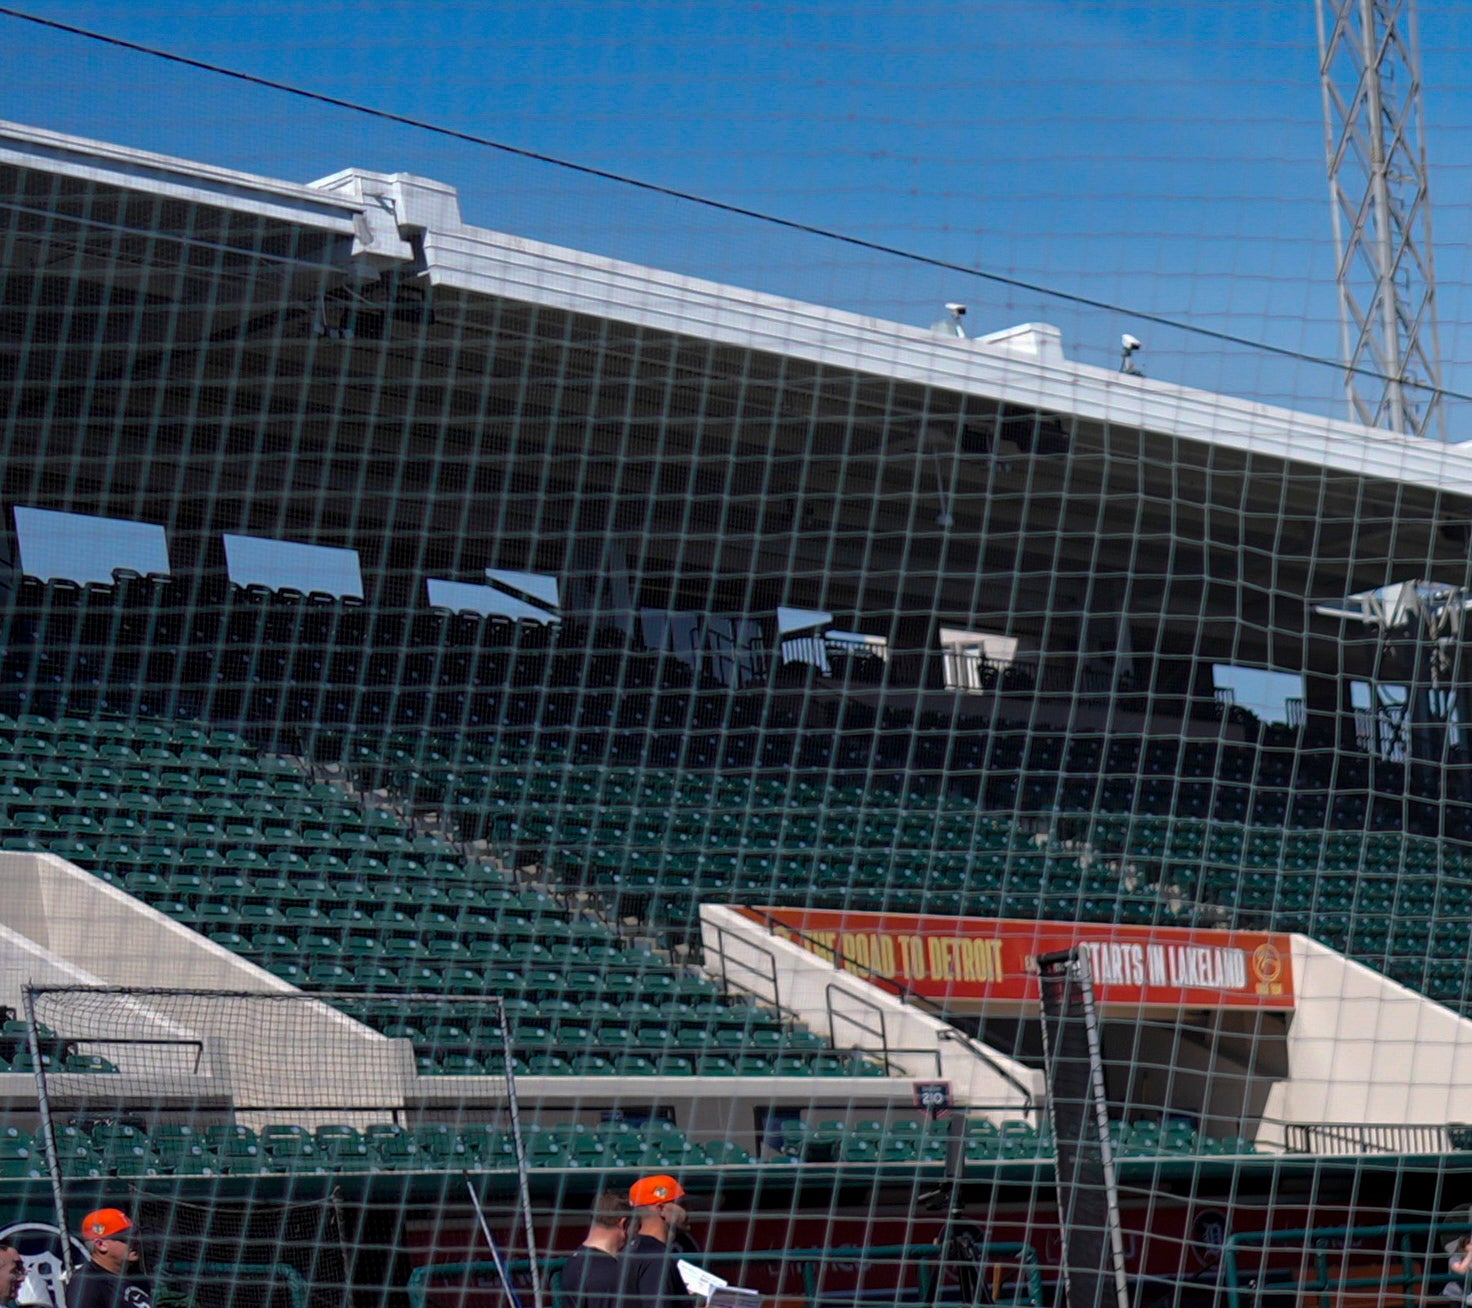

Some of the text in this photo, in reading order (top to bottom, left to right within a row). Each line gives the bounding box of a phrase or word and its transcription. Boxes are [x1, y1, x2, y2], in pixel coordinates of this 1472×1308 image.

[842, 932, 896, 980] ROAD
[898, 935, 925, 981] TO
[927, 936, 1004, 983] DETROIT
[1147, 943, 1167, 987] IN
[1168, 945, 1247, 989] LAKELAND
